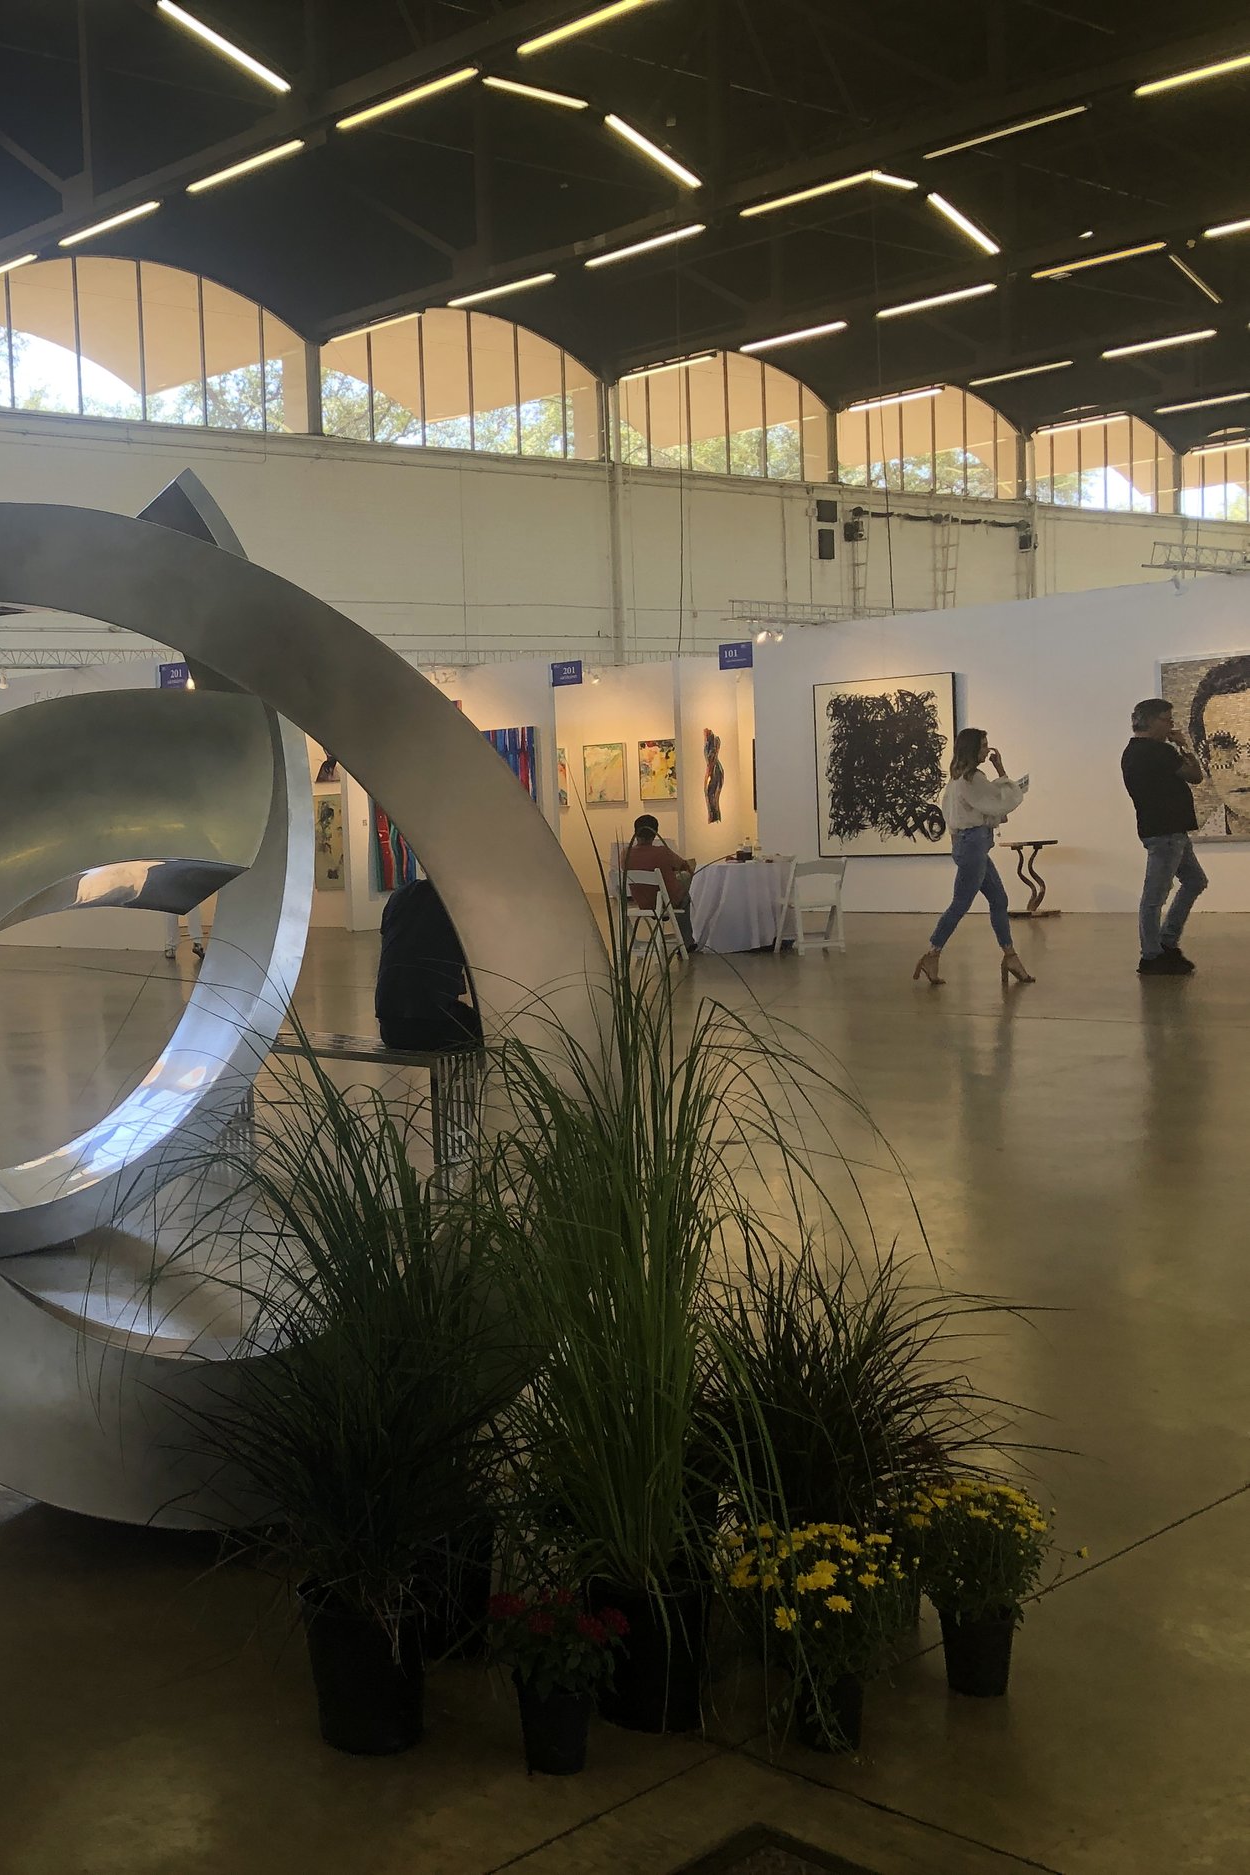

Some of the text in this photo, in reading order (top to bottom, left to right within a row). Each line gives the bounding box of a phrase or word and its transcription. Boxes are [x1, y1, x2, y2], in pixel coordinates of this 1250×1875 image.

[724, 649, 738, 659] 101
[170, 669, 182, 679] 201
[562, 666, 576, 675] 201
